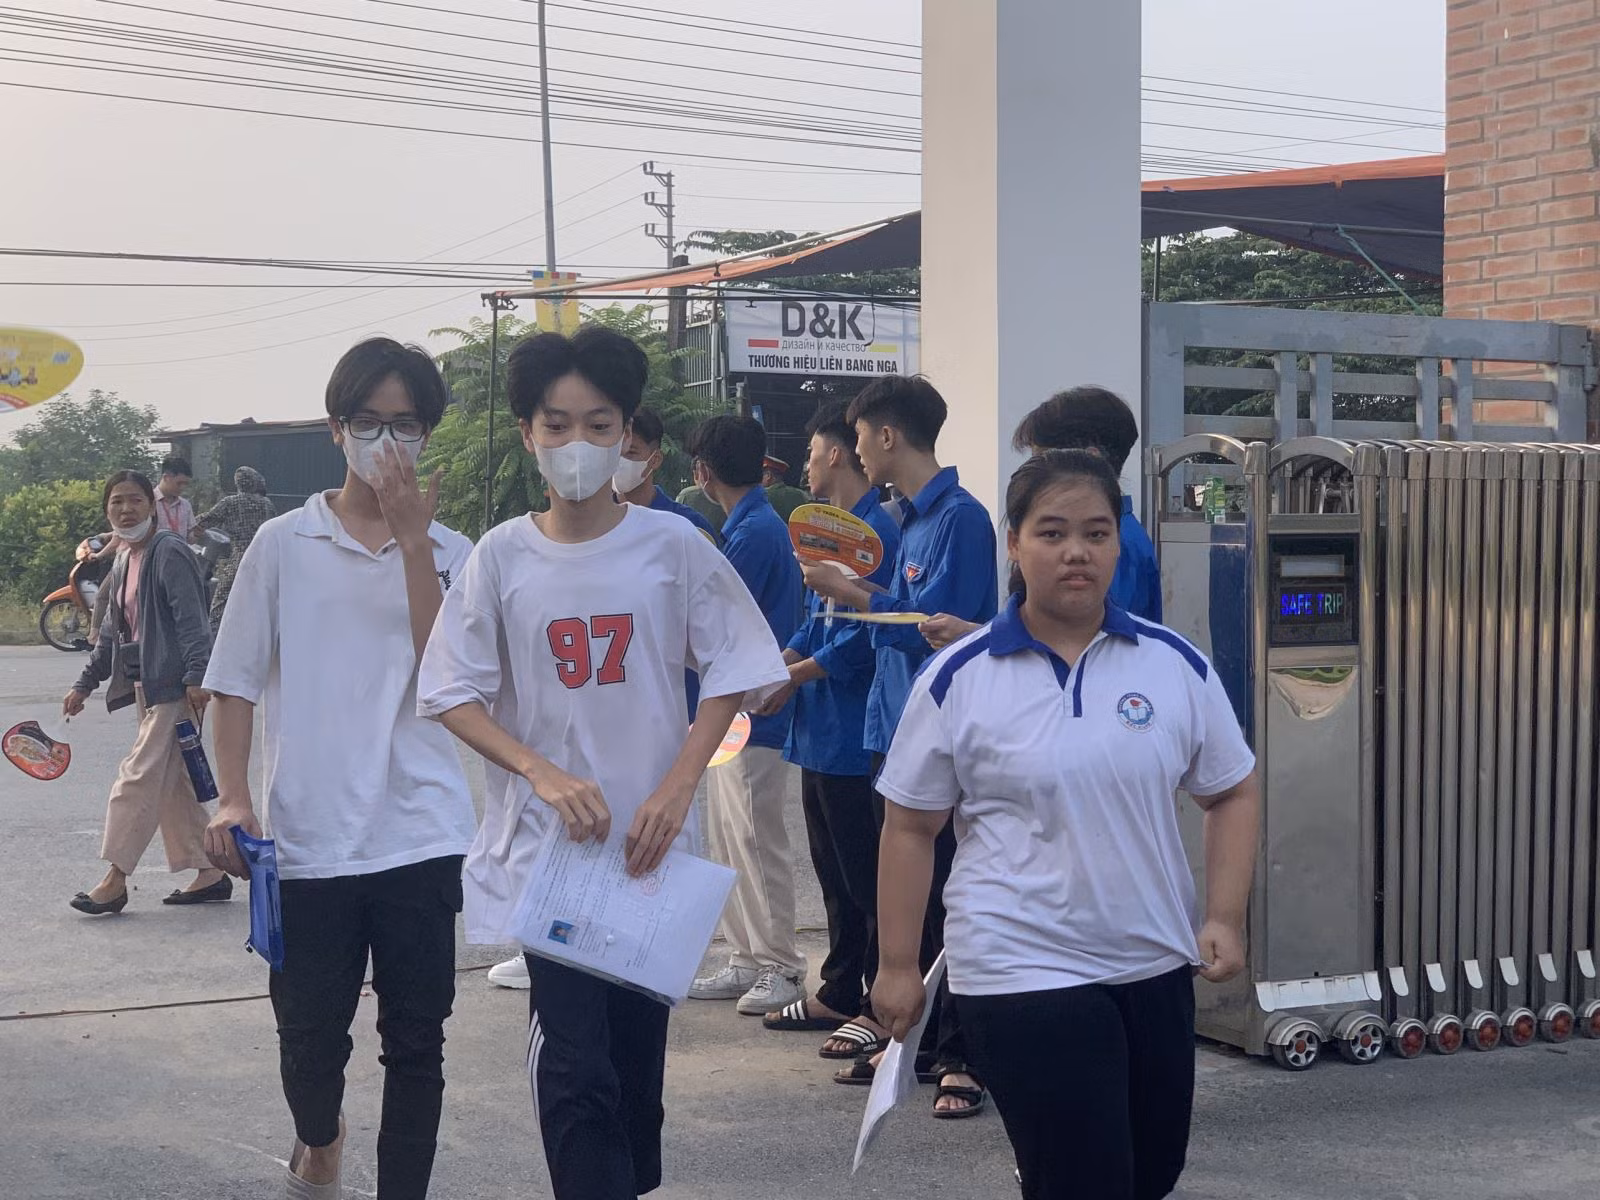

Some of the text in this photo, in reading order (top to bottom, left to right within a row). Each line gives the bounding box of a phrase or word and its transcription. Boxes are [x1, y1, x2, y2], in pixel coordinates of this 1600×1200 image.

[781, 300, 865, 341] D&K
[782, 338, 815, 351] дизайн
[825, 342, 866, 353] качество
[748, 354, 898, 373] THƯƠNG HIỆU LIÊN BANG NGA
[1281, 593, 1343, 615] SAFE TRIP
[547, 613, 633, 689] 97
